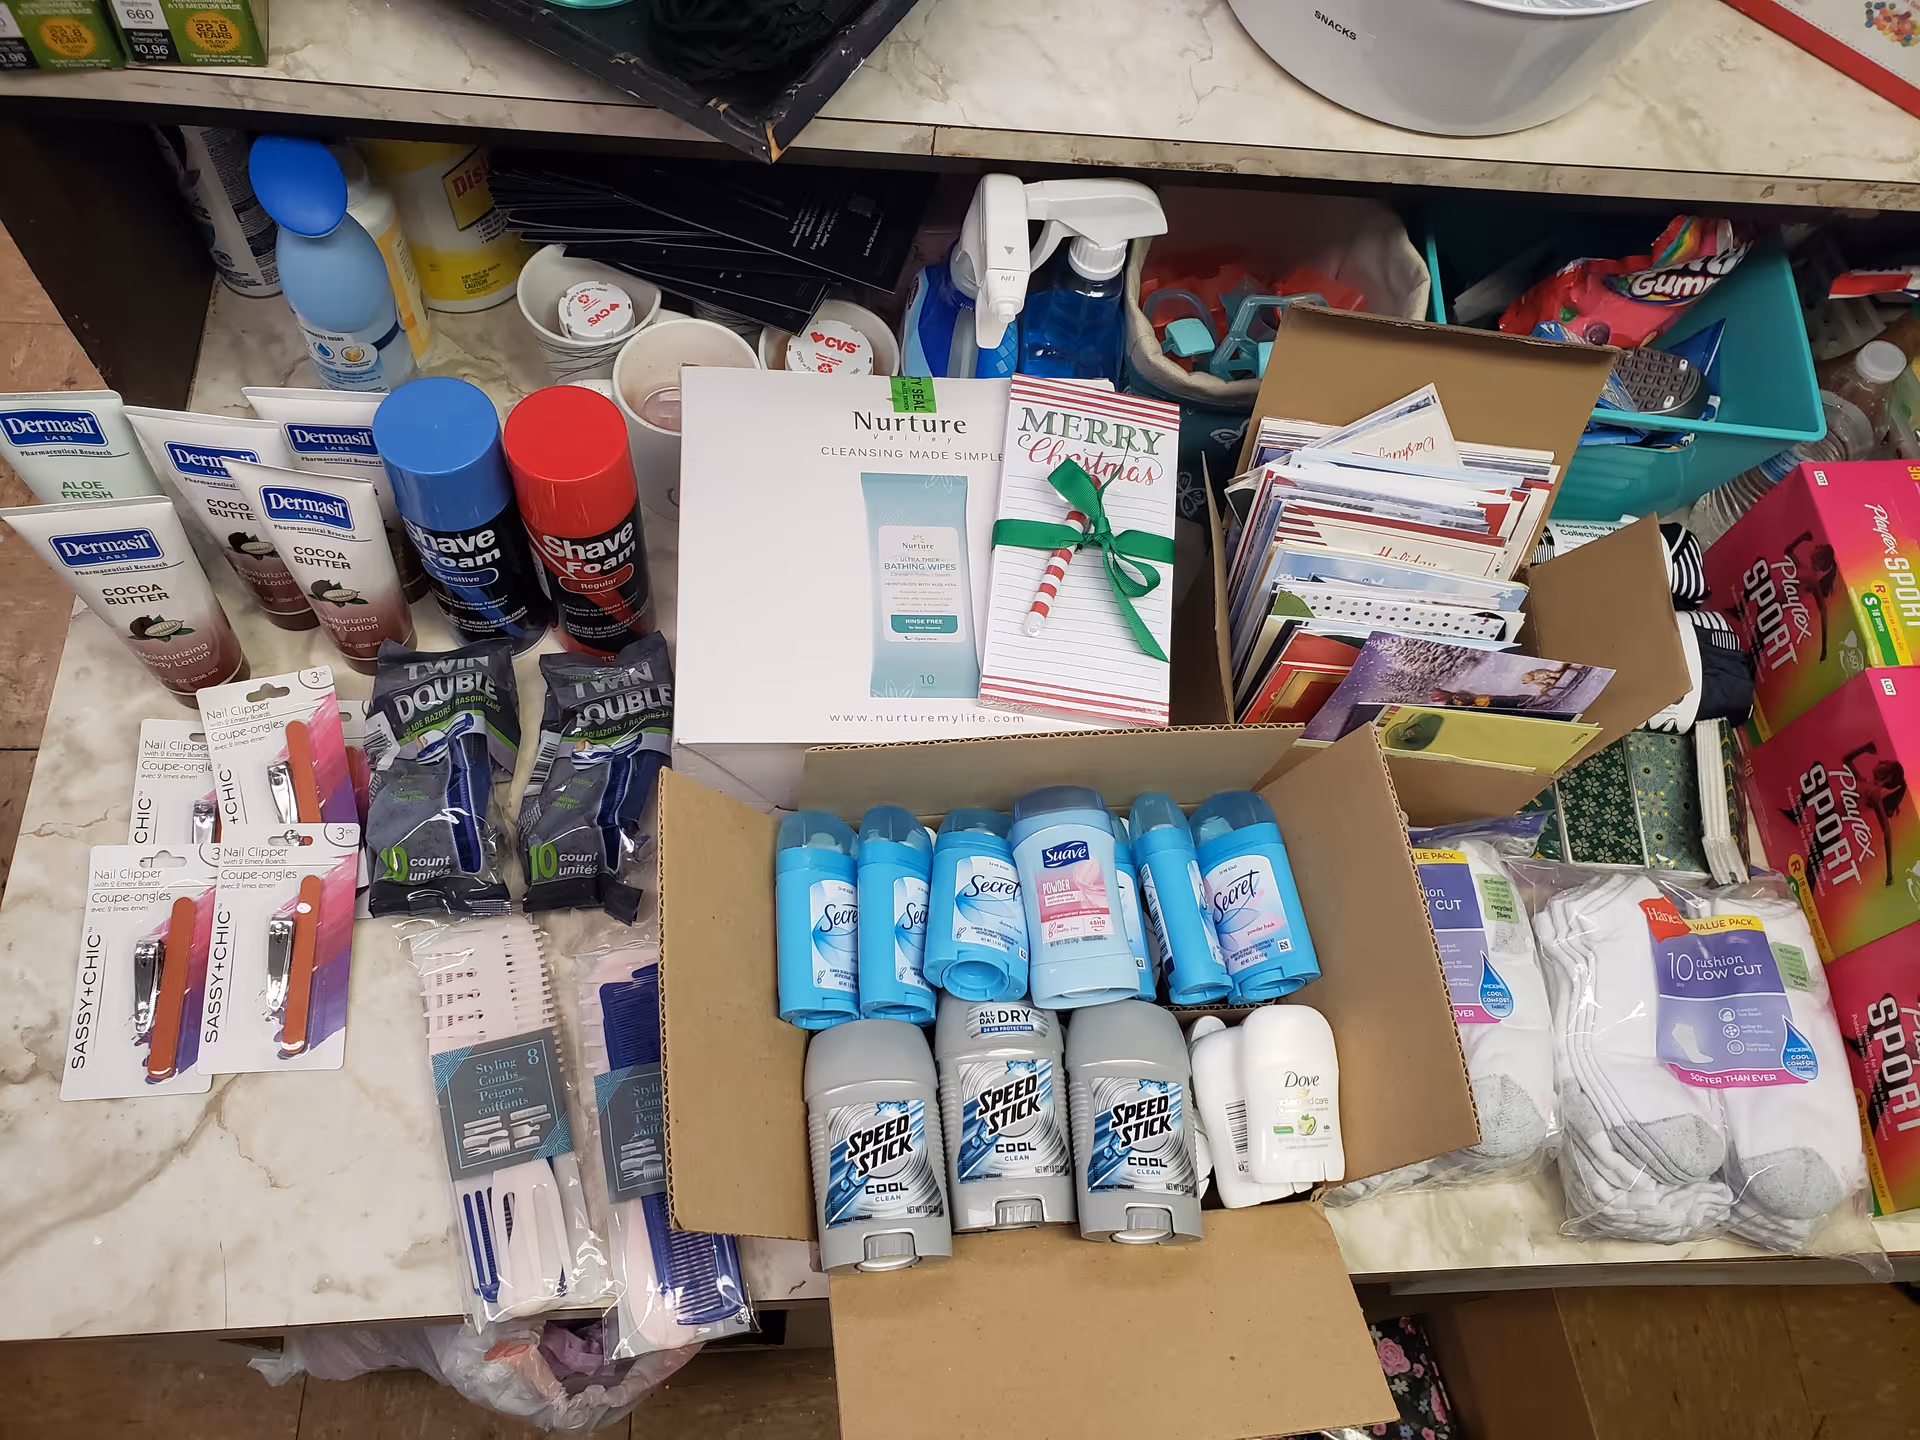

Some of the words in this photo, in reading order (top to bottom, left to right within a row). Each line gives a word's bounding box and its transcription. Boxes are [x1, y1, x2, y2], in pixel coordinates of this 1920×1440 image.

[127, 9, 154, 20] 660
[196, 24, 228, 32] 22.8
[1314, 10, 1357, 40] SNACKS
[196, 32, 232, 40] YEARS
[134, 44, 168, 54] $0.96
[588, 308, 610, 326] CVS
[824, 336, 857, 354] CVS
[912, 389, 926, 411] SEAL
[5, 416, 96, 436] Dermasil
[853, 411, 968, 435] Nurture
[44, 434, 73, 442] LABS
[294, 428, 372, 446] Dermasil
[1018, 407, 1166, 456] MERRY
[873, 434, 952, 444] Valley
[301, 456, 352, 464] Pharmaceutical
[820, 446, 904, 460] CLEANSING
[909, 450, 949, 460] MADE
[954, 451, 1004, 462] SIMPLE
[62, 481, 104, 490] ALOE
[1816, 472, 1826, 486] LOT
[61, 490, 114, 499] FRESH
[268, 492, 346, 520] Dermasil
[299, 513, 325, 522] LABS
[274, 524, 326, 534] Pharmaceutical
[326, 530, 356, 540] Research
[401, 517, 496, 554] Shave
[1864, 504, 1899, 555] Playtex
[60, 534, 152, 558] Dermasil
[542, 522, 634, 560] Shave
[902, 542, 934, 550] Nurture
[98, 553, 128, 561] LABS
[294, 546, 347, 560] COCOA
[423, 547, 501, 568] Foam
[566, 540, 636, 574] Foam
[74, 566, 133, 576] Pharmaceutical
[134, 561, 168, 571] Research
[294, 556, 352, 570] BUTTER
[884, 562, 925, 570] BATHING
[926, 563, 956, 571] WIPES
[436, 570, 480, 583] Sensitive
[102, 584, 163, 597] COCOA
[580, 578, 617, 590] Regular
[1874, 584, 1886, 594] R
[104, 592, 170, 606] BUTTER
[1771, 554, 1812, 644] Playtex
[1864, 597, 1878, 606] S
[499, 606, 526, 622] CHILDREN
[1742, 558, 1798, 670] SPORT
[344, 623, 379, 632] Lotion
[604, 622, 622, 630] REACH
[174, 650, 211, 668] Lotion
[404, 656, 490, 682] TWIN
[312, 671, 320, 684] 3
[571, 662, 654, 698] TWIN
[919, 674, 935, 685] 10
[1884, 680, 1894, 694] LOT
[393, 670, 498, 724] DOUBLE
[206, 708, 228, 720] Nail
[231, 701, 270, 717] Clipper
[424, 706, 452, 725] RAZORS
[829, 712, 1026, 724] www.nurturemylife.com
[210, 718, 285, 742] Coupe-ongles
[144, 740, 166, 750] Nail
[1828, 764, 1876, 863] Playtex
[1799, 764, 1861, 886] SPORT
[336, 826, 345, 840] 3
[212, 848, 221, 860] 3
[224, 847, 246, 857] Nail
[248, 847, 288, 860] Clipper
[529, 842, 558, 879] 10
[558, 852, 598, 864] count
[1045, 846, 1087, 862] Suave
[1431, 852, 1456, 860] PACK
[245, 858, 264, 866] Emery
[410, 854, 451, 868] count
[1790, 860, 1800, 874] R
[94, 868, 118, 880] Nail
[119, 868, 162, 882] Clipper
[220, 869, 298, 882] Coupe-ongles
[409, 866, 451, 882] unités
[558, 864, 598, 877] unités
[116, 881, 136, 890] Emery
[137, 880, 160, 888] Boards
[964, 874, 1022, 902] Secret
[1042, 878, 1070, 894] POWDER
[92, 891, 172, 905] Coupe-ongles
[1214, 868, 1260, 924] Secret
[1435, 900, 1462, 910] CUT
[1247, 926, 1264, 936] powder
[1264, 922, 1276, 930] fresh
[1692, 920, 1727, 932] VALUE
[1728, 918, 1754, 926] PACK
[1666, 952, 1694, 981] 10
[1696, 954, 1744, 968] cushion
[1696, 969, 1728, 981] LOW
[1734, 964, 1763, 975] CUT
[204, 911, 232, 1043] SASSY+CHIC
[72, 933, 102, 1069] SASSY+CHIC
[980, 1010, 996, 1018] ALL
[998, 1010, 1031, 1023] DRY
[1862, 1024, 1874, 1058] Protection
[527, 1048, 540, 1065] 8
[476, 1058, 517, 1076] Styling
[478, 1071, 519, 1087] Combs
[1284, 1070, 1320, 1088] Dove
[1690, 1073, 1723, 1084] SOFTER
[1724, 1074, 1750, 1082] THAN
[1752, 1073, 1777, 1082] EVER
[480, 1085, 524, 1102] Peignes
[979, 1074, 1038, 1117] SPEED
[478, 1096, 529, 1116] coiffants
[1112, 1094, 1169, 1129] SPEED
[988, 1094, 1041, 1136] STICK
[848, 1114, 910, 1159] SPEED
[1121, 1114, 1172, 1149] STICK
[996, 1142, 1036, 1153] COOL
[858, 1133, 913, 1178] STICK
[1004, 1154, 1030, 1162] CLEAN
[1128, 1157, 1168, 1167] COOL
[1034, 1165, 1043, 1174] NET
[1136, 1168, 1161, 1176] CLEAN
[865, 1182, 909, 1194] COOL
[874, 1194, 902, 1202] CLEAN
[906, 1206, 915, 1214] NET
